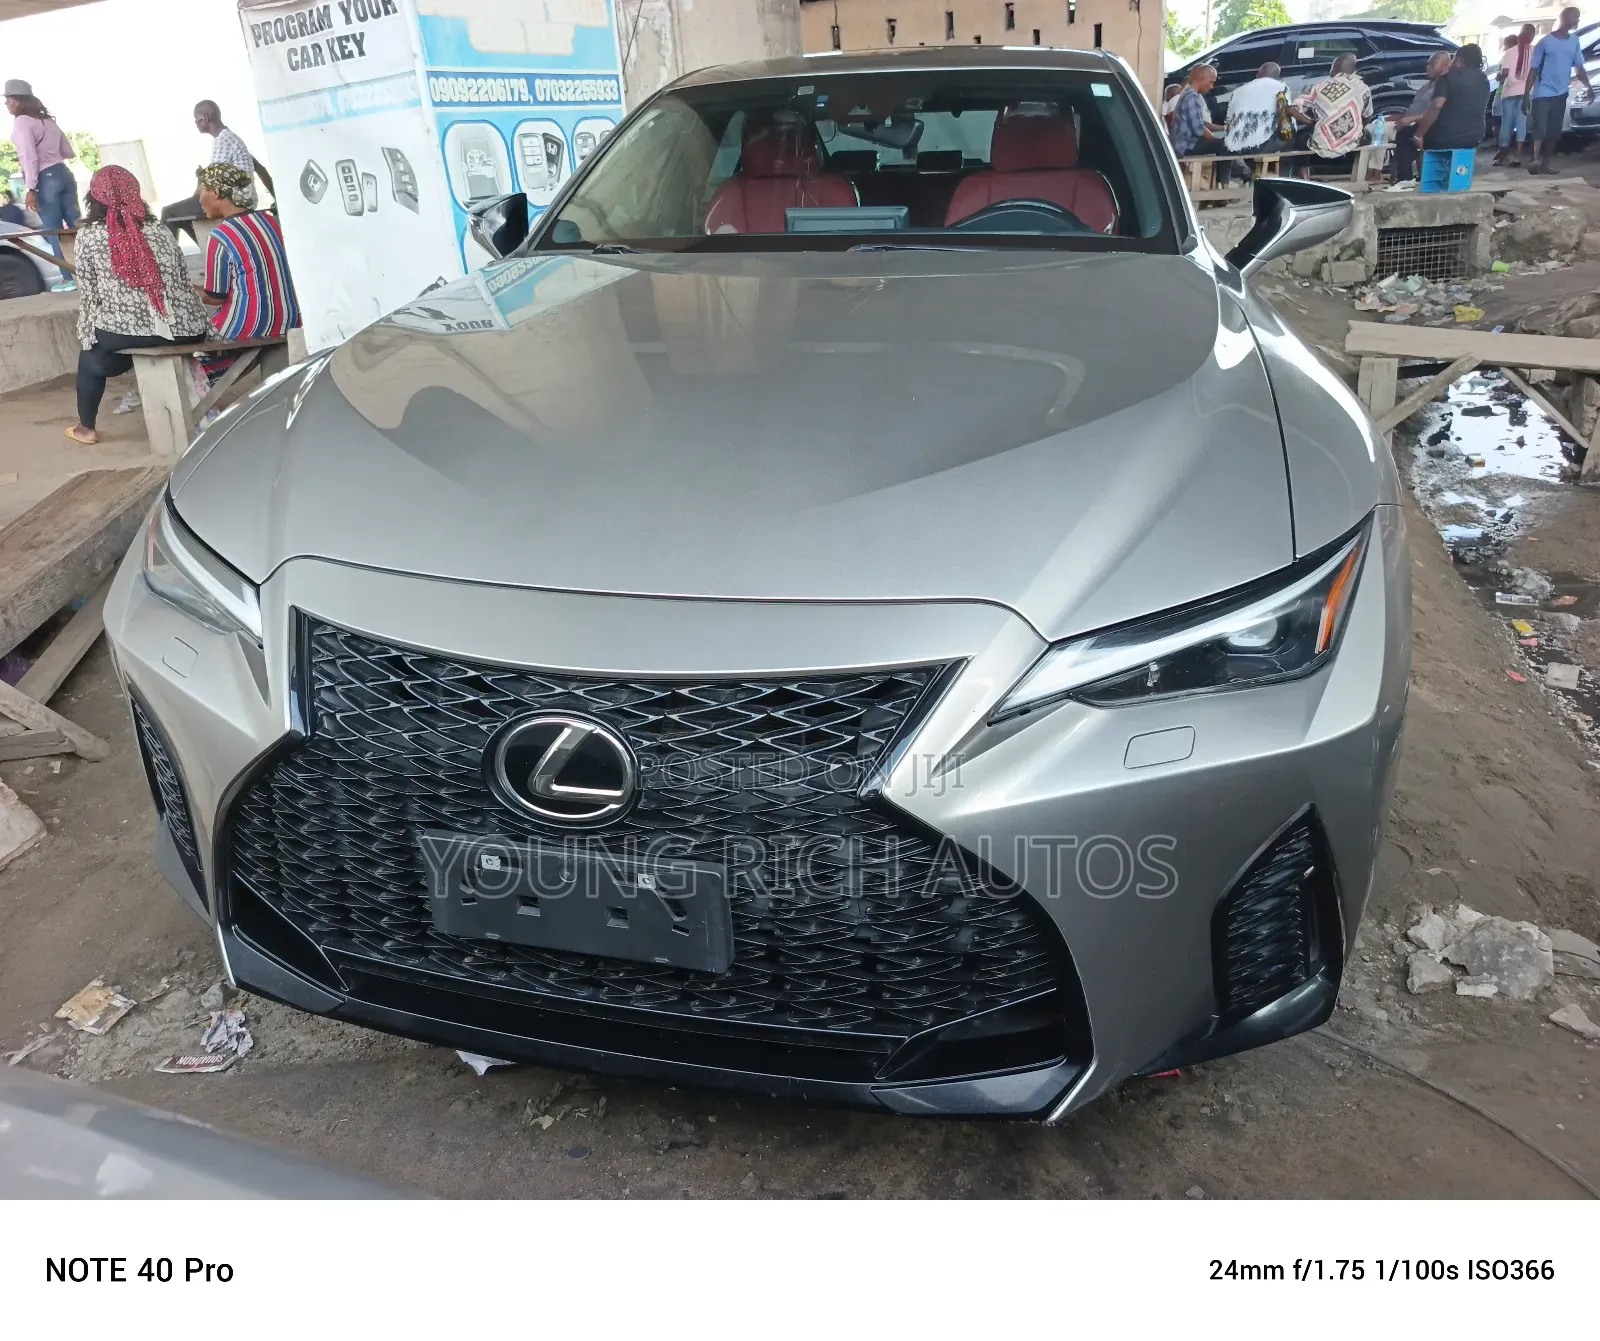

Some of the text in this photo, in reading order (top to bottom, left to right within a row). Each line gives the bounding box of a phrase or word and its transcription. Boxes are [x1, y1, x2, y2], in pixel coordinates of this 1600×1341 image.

[250, 0, 399, 48] PROGRAM YOUR
[286, 31, 367, 72] CAR KEY
[429, 77, 535, 105] 09092206179,
[535, 78, 619, 102] 07032255933
